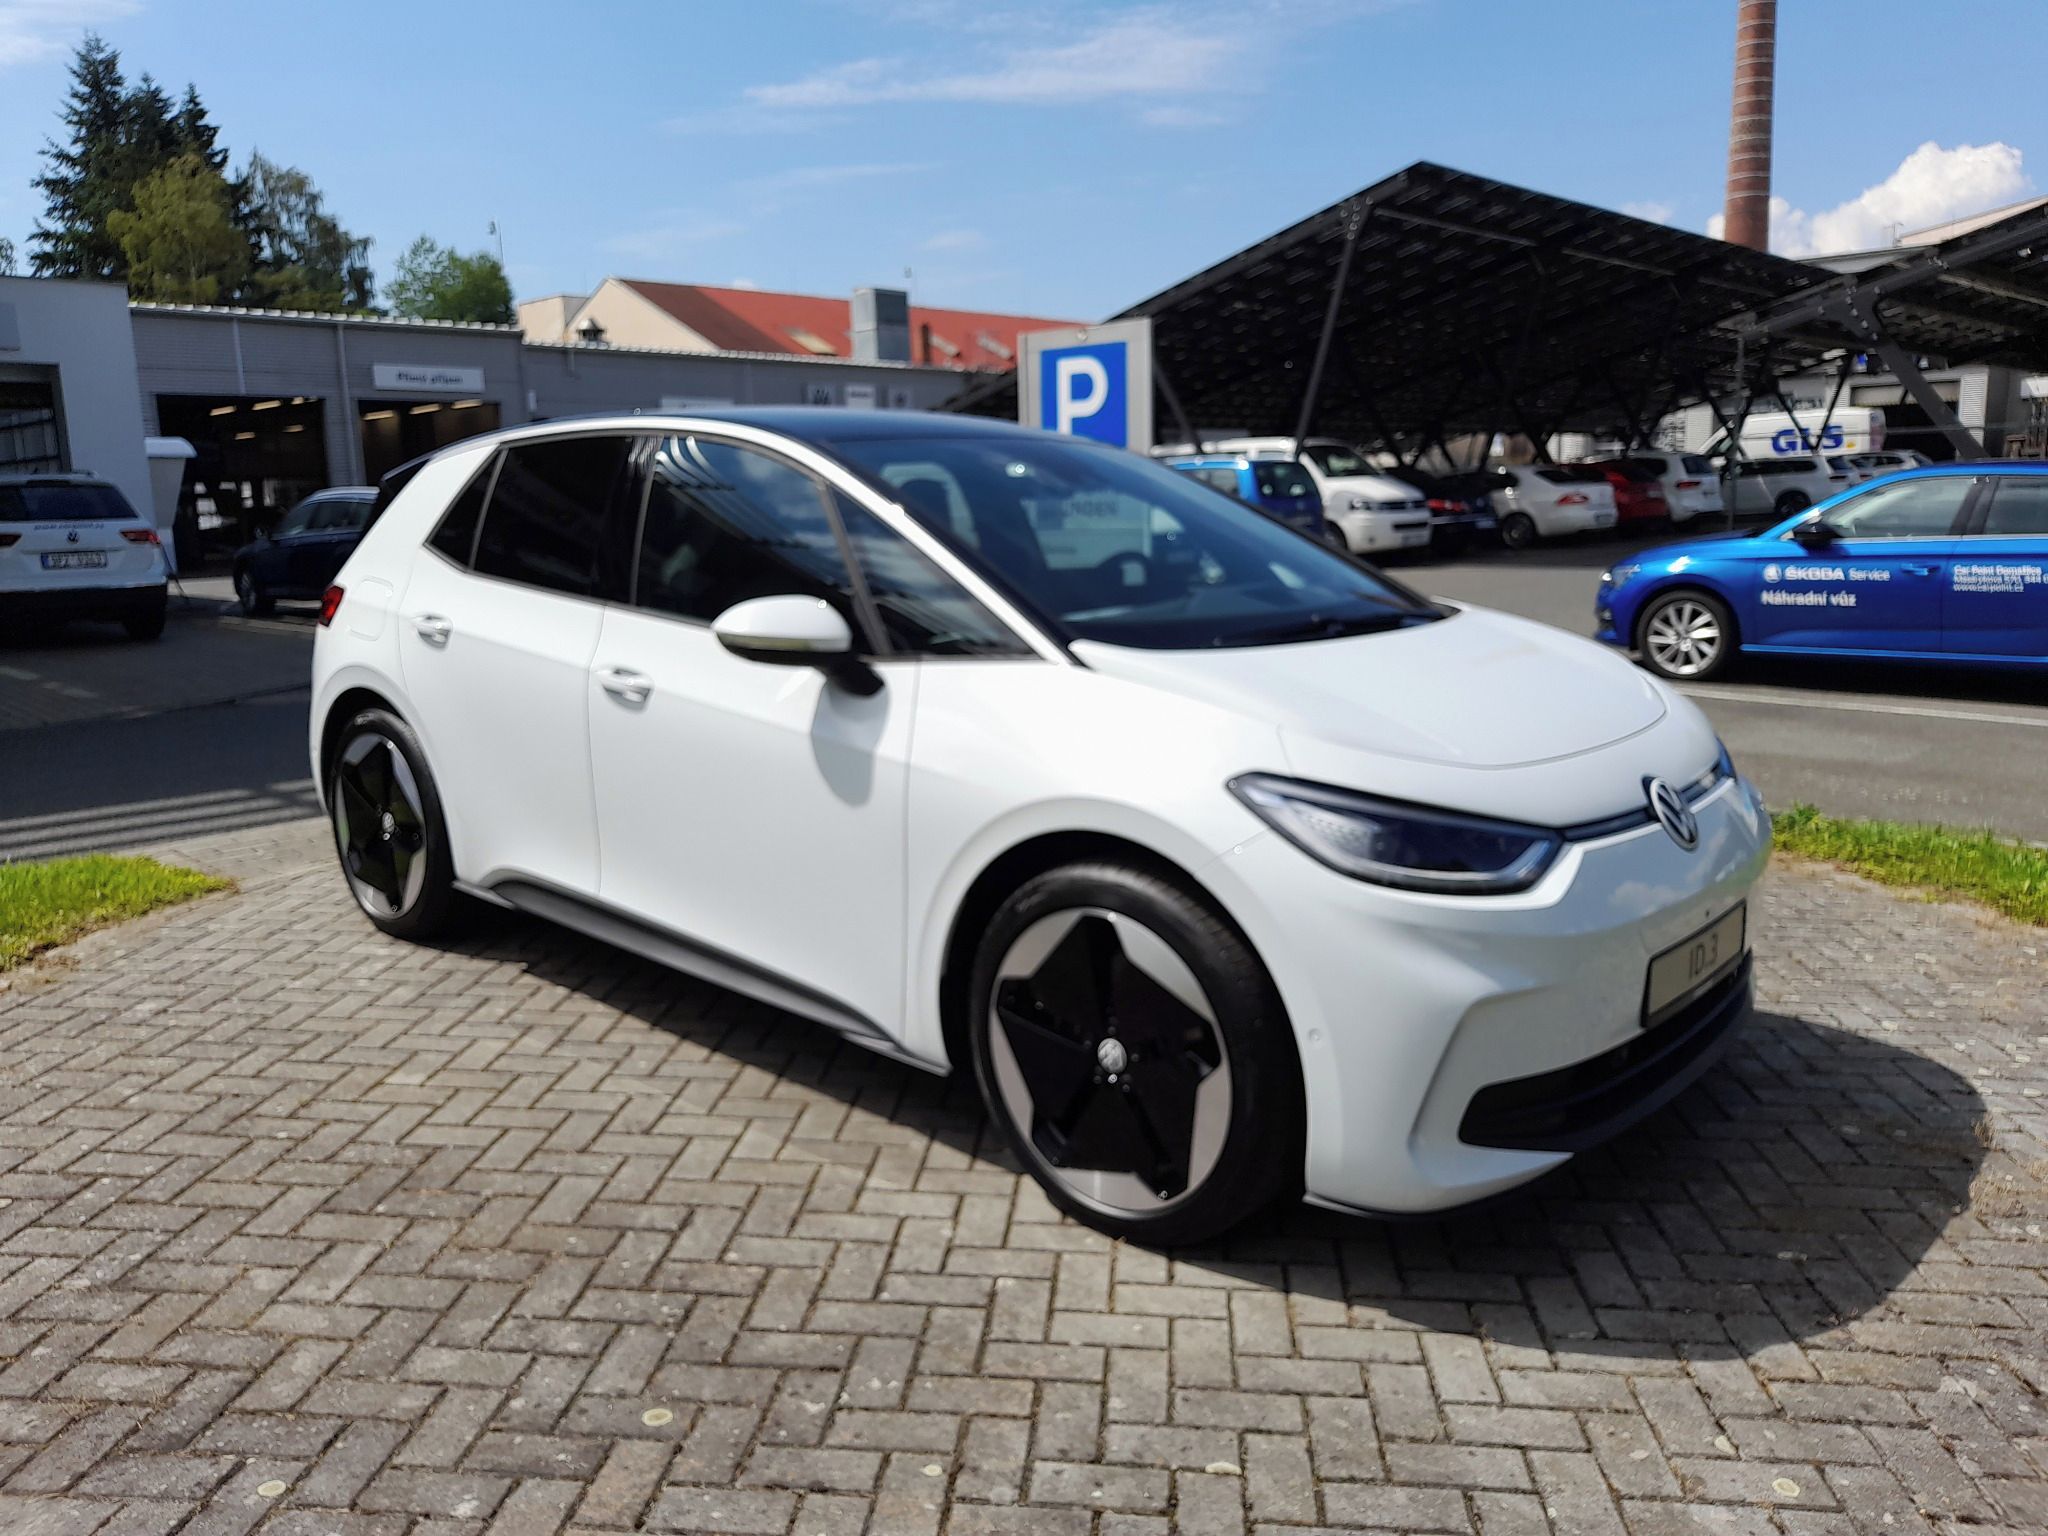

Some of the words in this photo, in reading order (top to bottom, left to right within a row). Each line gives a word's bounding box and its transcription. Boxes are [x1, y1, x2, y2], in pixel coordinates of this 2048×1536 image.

[1056, 355, 1109, 435] P
[1771, 425, 1844, 457] GLS
[1784, 564, 1845, 581] ŠKODA
[1847, 567, 1891, 582] Service
[1761, 588, 1828, 607] Náhradní
[1829, 589, 1857, 607] vůz
